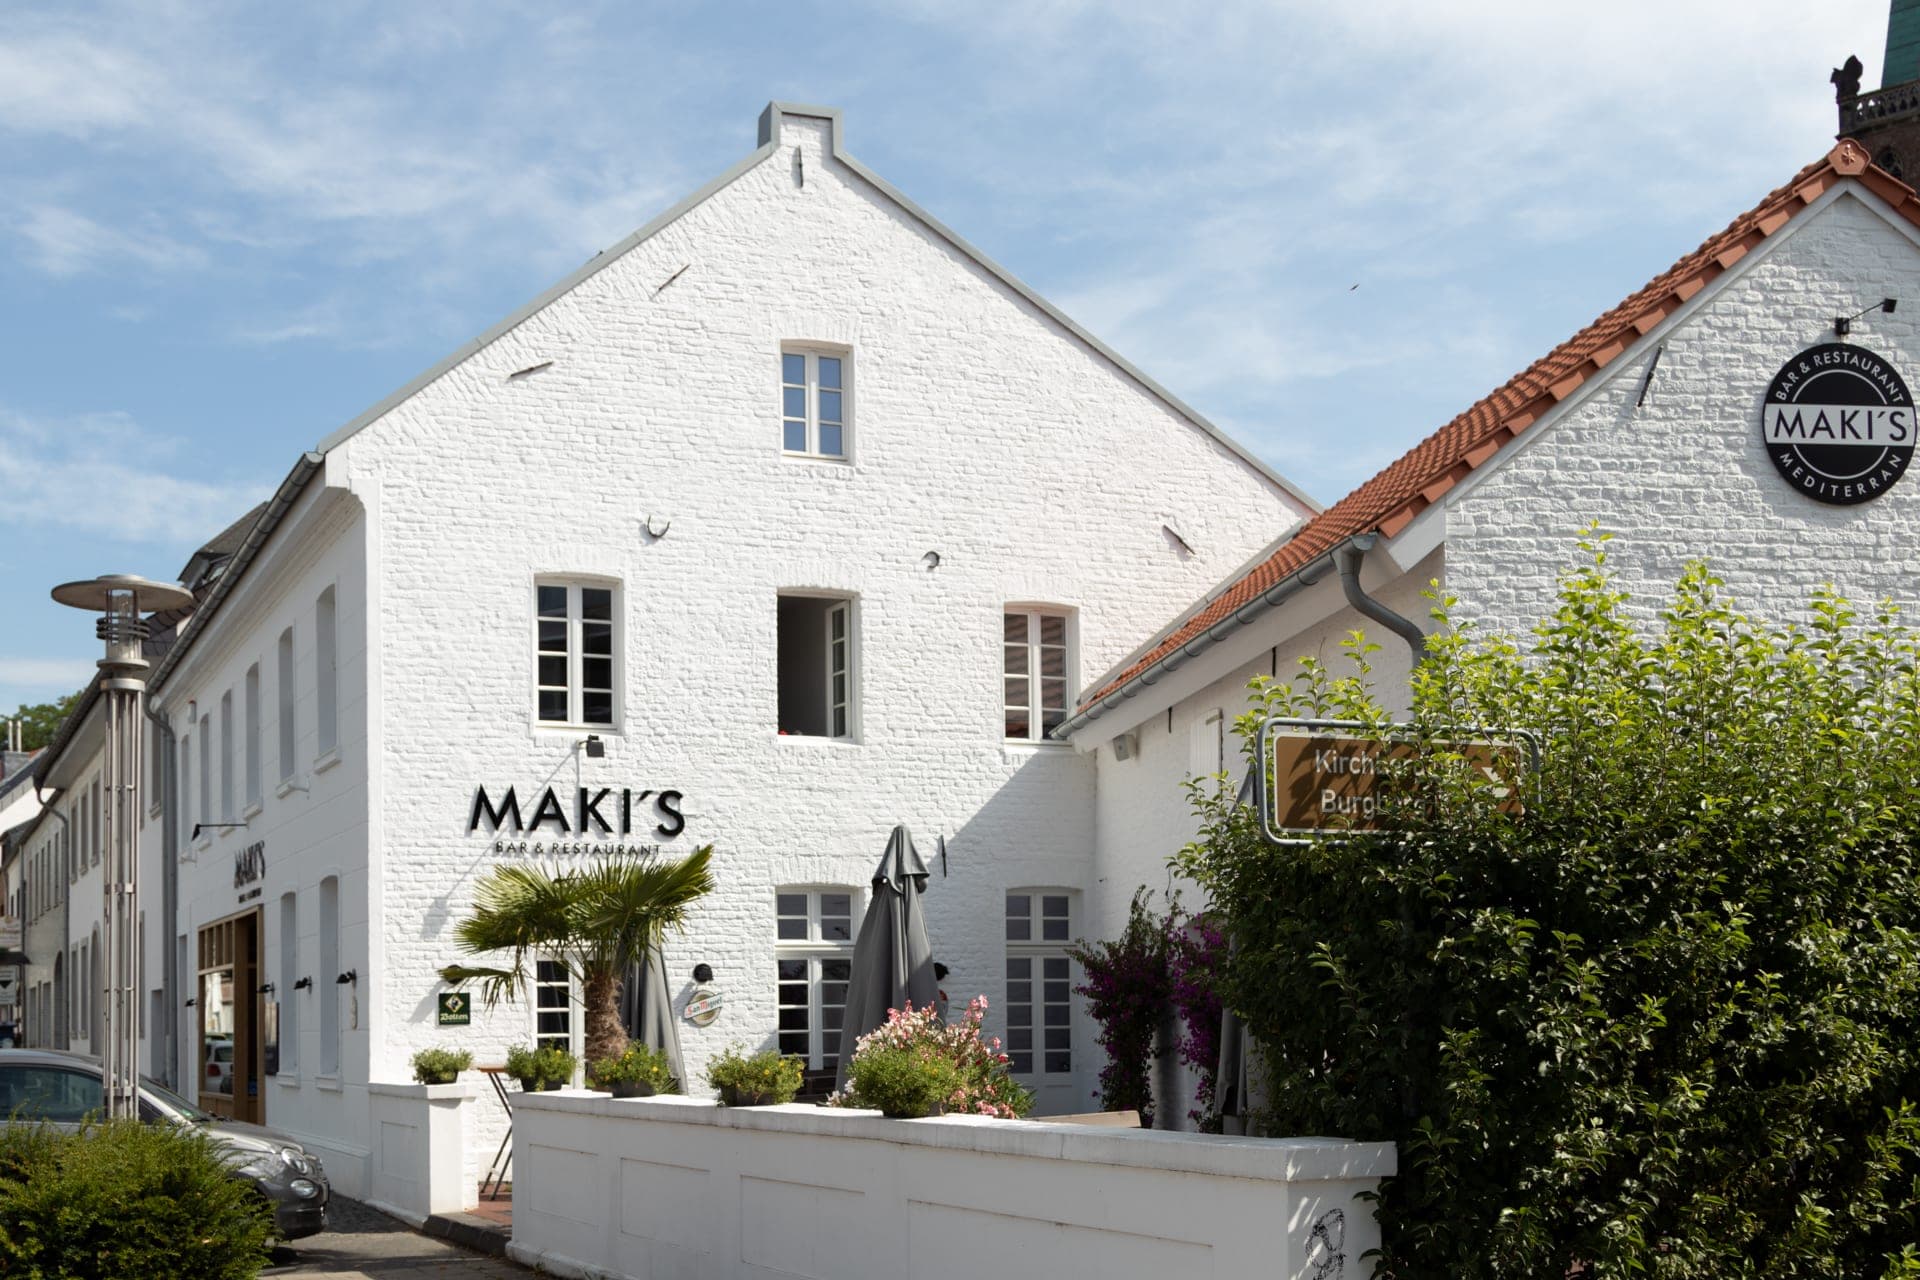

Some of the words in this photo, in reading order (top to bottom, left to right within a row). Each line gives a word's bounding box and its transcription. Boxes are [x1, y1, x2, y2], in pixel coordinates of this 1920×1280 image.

[1775, 371, 1800, 401] BAR
[1799, 361, 1811, 374] &
[1813, 351, 1904, 403] RESTAURANT
[1779, 452, 1902, 497] MEDITERRAN
[496, 841, 528, 853] BAR
[534, 842, 544, 853] &
[552, 843, 661, 855] RESTAURANT
